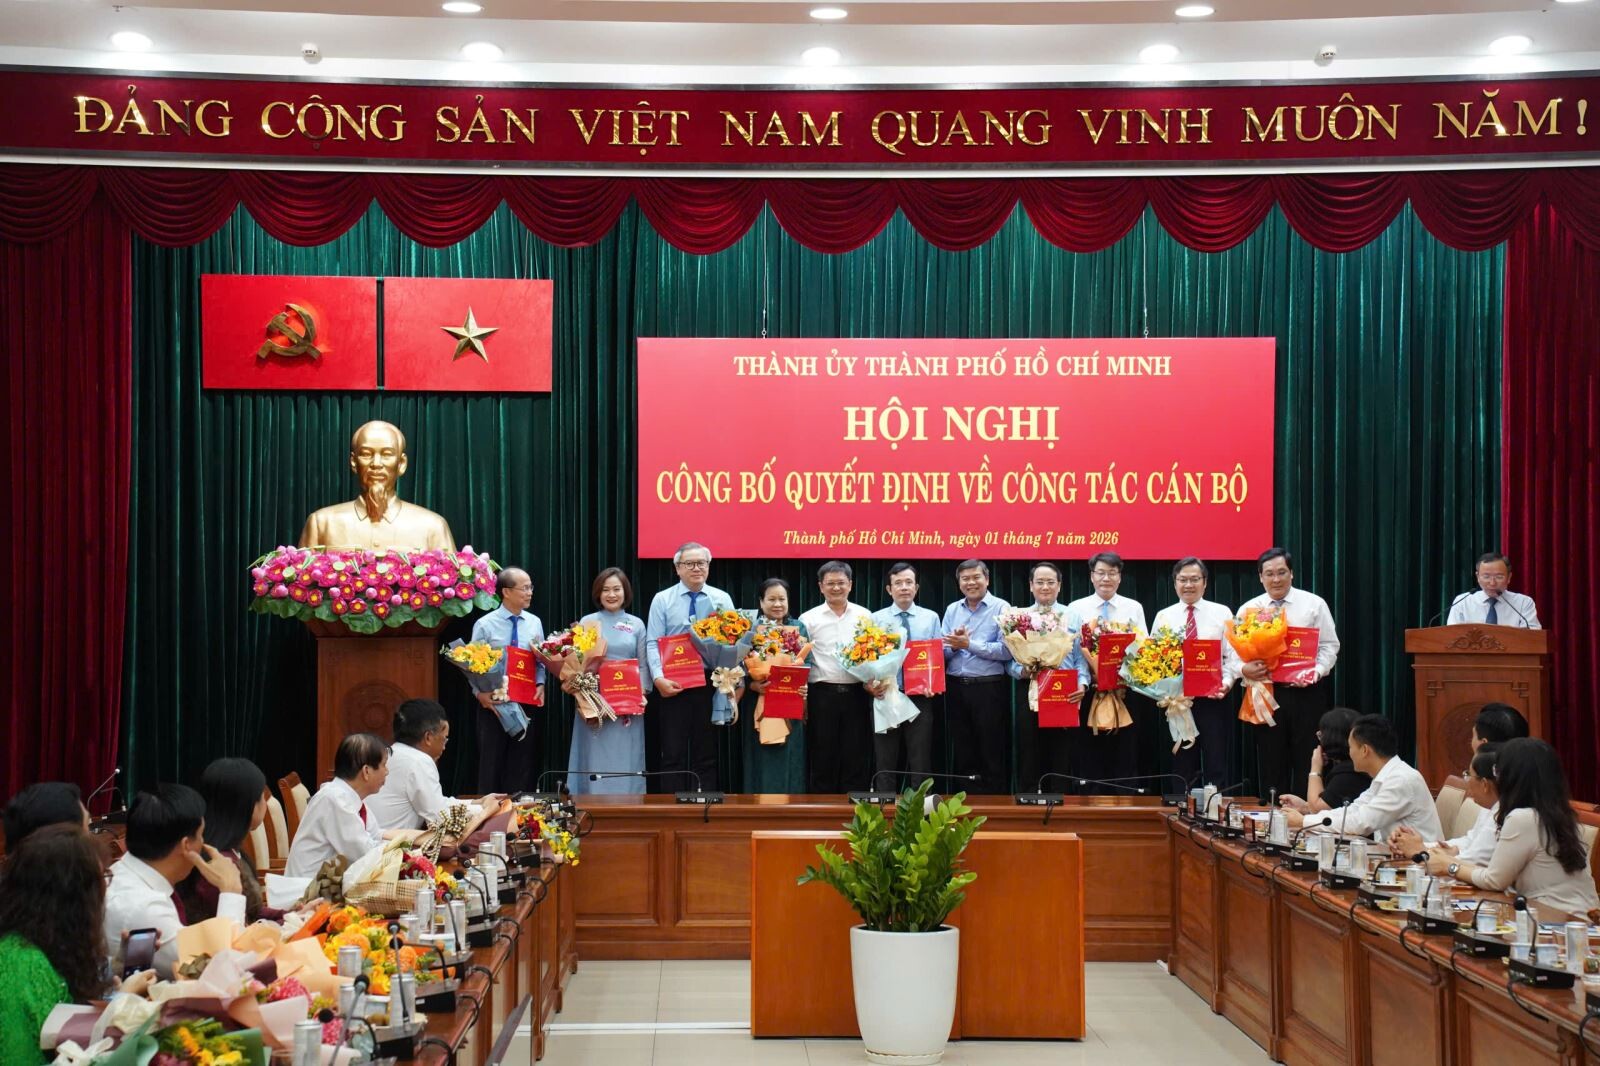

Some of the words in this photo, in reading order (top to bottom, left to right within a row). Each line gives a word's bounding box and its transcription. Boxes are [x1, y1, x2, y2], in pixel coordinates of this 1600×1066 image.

[73, 84, 233, 137] ĐẢNG
[261, 95, 407, 149] CỘNG
[436, 95, 538, 144] SẢN
[569, 101, 689, 155] VIỆT
[720, 111, 843, 146] NAM
[872, 110, 1052, 155] QUANG
[1077, 108, 1212, 144] VINH
[1241, 93, 1401, 142] MUÔN
[733, 350, 818, 376] THÀNH
[825, 348, 859, 376] ỦY
[864, 350, 949, 376] THÀNH
[956, 347, 1007, 376] PHỐ
[1014, 346, 1049, 376] HỒ
[1056, 350, 1099, 376] CHÍ
[1106, 356, 1171, 376] MINH
[844, 396, 928, 450] HỘI
[943, 406, 1060, 450] NGHỊ
[656, 462, 732, 504] CÔNG
[739, 456, 777, 503] BỐ
[785, 457, 875, 510] QUYẾT
[882, 472, 950, 511] ĐỊNH
[958, 454, 992, 503] VỀ
[1002, 463, 1078, 503] CÔNG
[1086, 463, 1138, 503] TÁC
[1147, 463, 1203, 503] CÁN
[1210, 463, 1248, 512] BỘ
[784, 531, 825, 544] Thành
[829, 529, 856, 547] phố
[858, 529, 877, 545] Hồ
[881, 531, 904, 545] Chí
[908, 531, 945, 547] Minh,
[949, 531, 981, 547] ngày
[985, 531, 999, 544] 01
[1003, 531, 1042, 547] tháng
[1046, 532, 1053, 544] 7
[1057, 532, 1086, 544] năm
[1089, 532, 1119, 544] 2026
